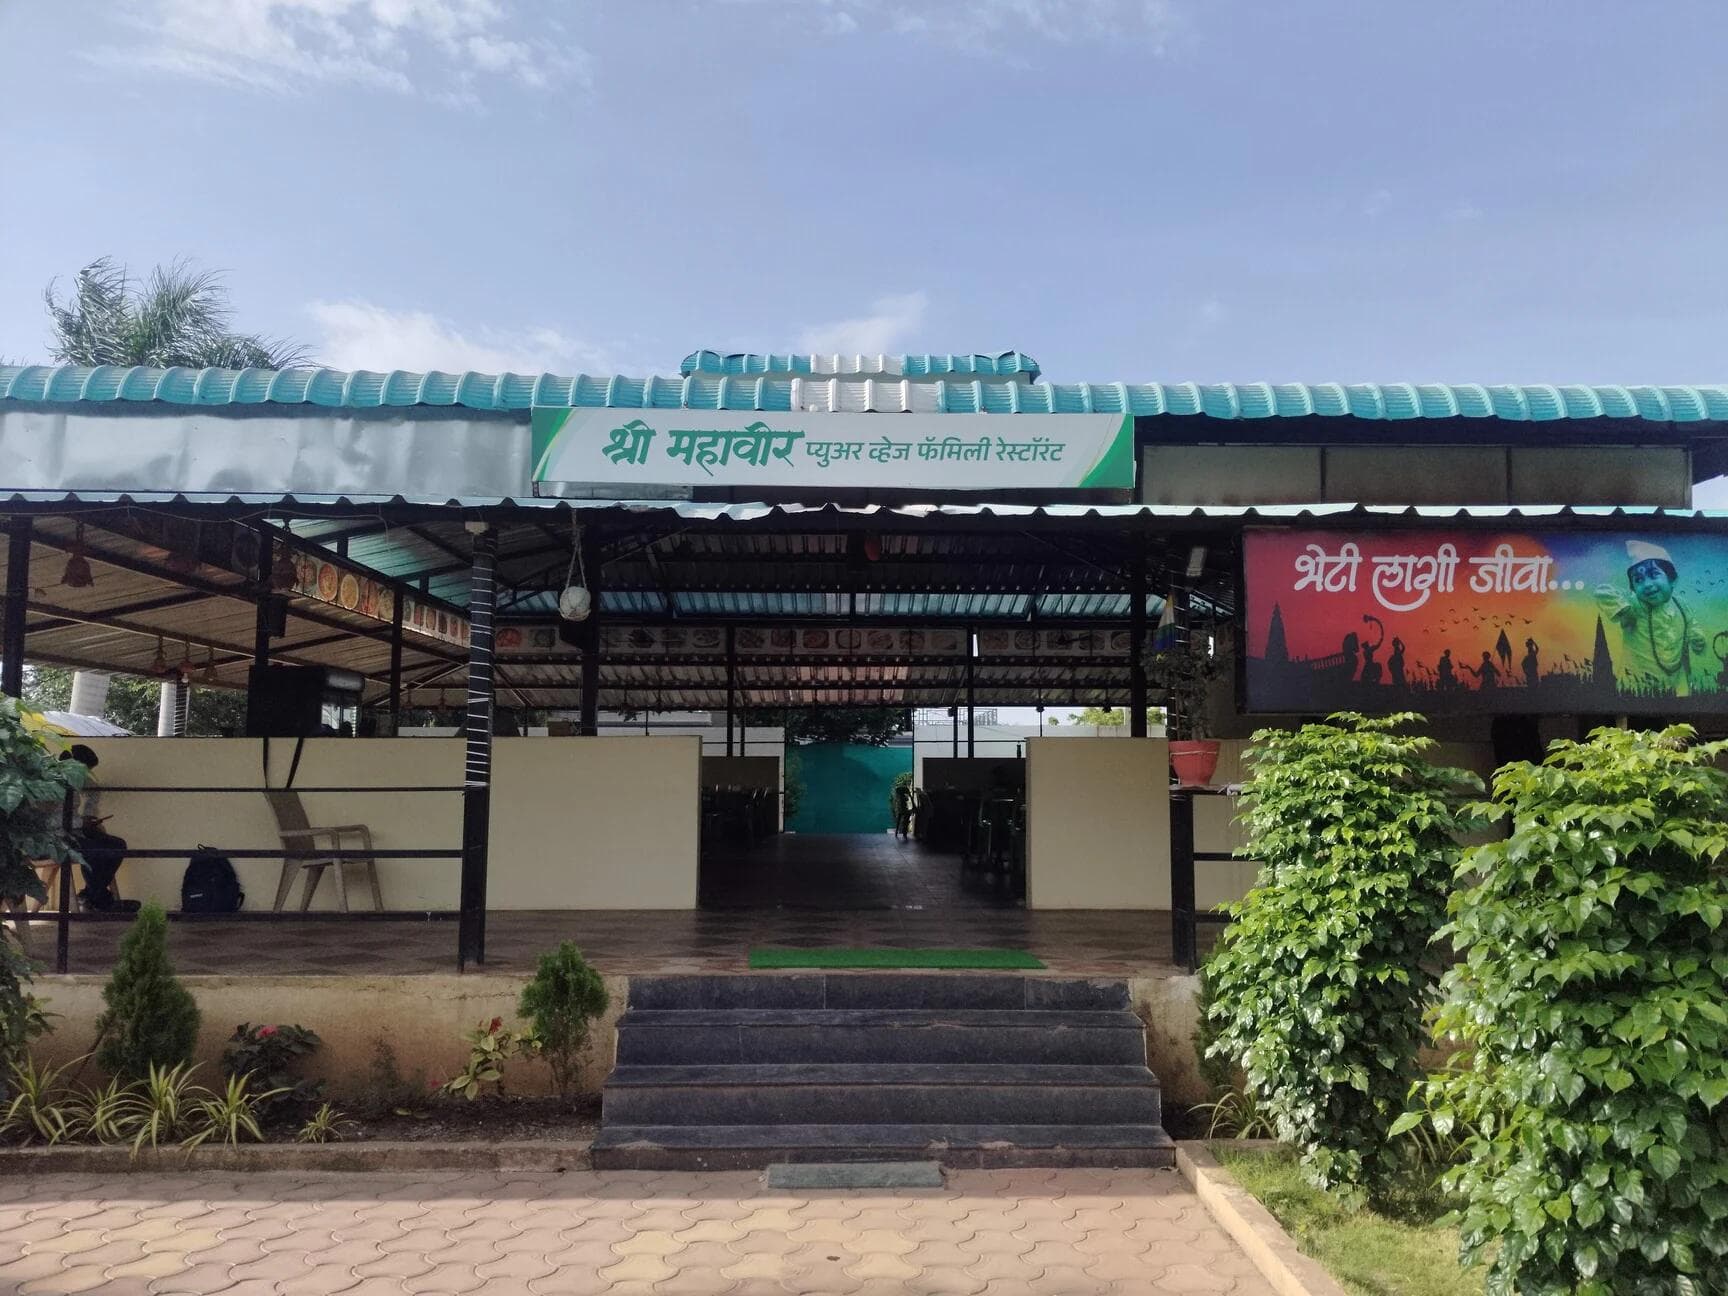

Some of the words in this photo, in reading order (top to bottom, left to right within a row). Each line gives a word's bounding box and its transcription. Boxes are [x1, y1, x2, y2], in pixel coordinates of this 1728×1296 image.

[602, 419, 657, 465] श्री
[666, 421, 805, 477] महावीर
[806, 442, 864, 467] प्युअर
[869, 436, 913, 463] व्हेज
[917, 437, 992, 461] फॅमिली
[996, 437, 1066, 461] रेस्टॉरंट
[1294, 542, 1363, 592] भेटी
[1371, 543, 1460, 612] लागी
